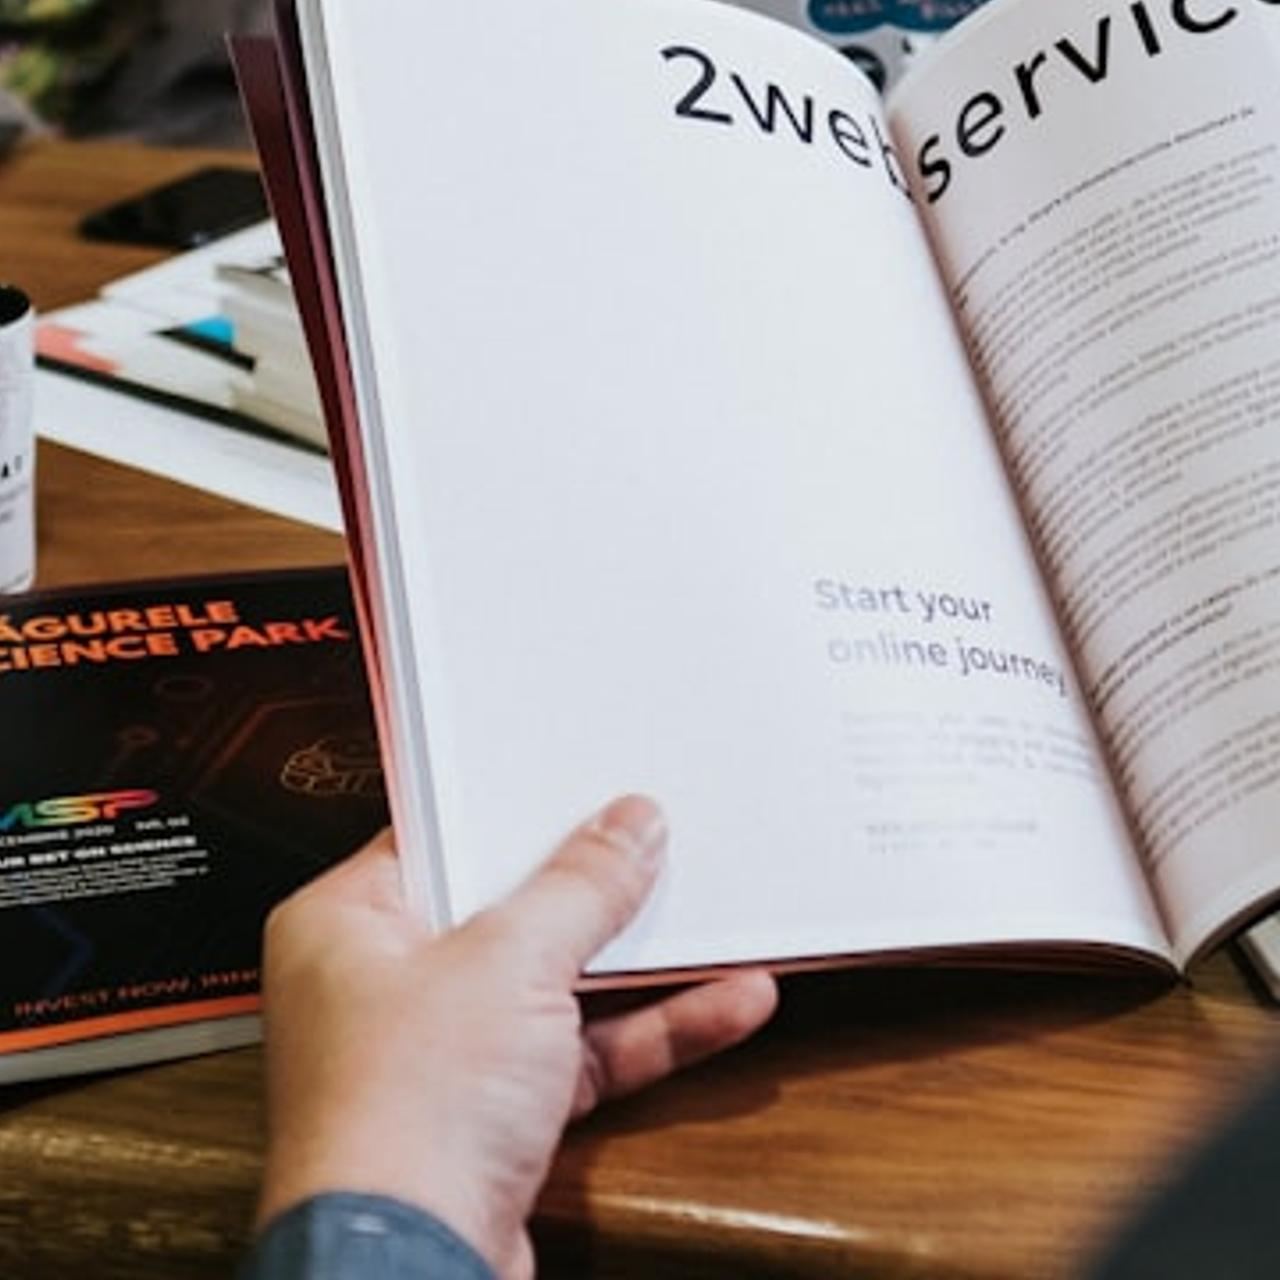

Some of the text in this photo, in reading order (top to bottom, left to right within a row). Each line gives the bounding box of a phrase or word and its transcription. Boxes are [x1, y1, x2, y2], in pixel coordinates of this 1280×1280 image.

[815, 578, 993, 623] Start your
[189, 616, 351, 653] PARK
[827, 629, 948, 666] online
[28, 850, 70, 867] BET
[73, 846, 108, 861] ON
[109, 834, 197, 856] SCIENCE
[13, 986, 111, 1018] INVEST
